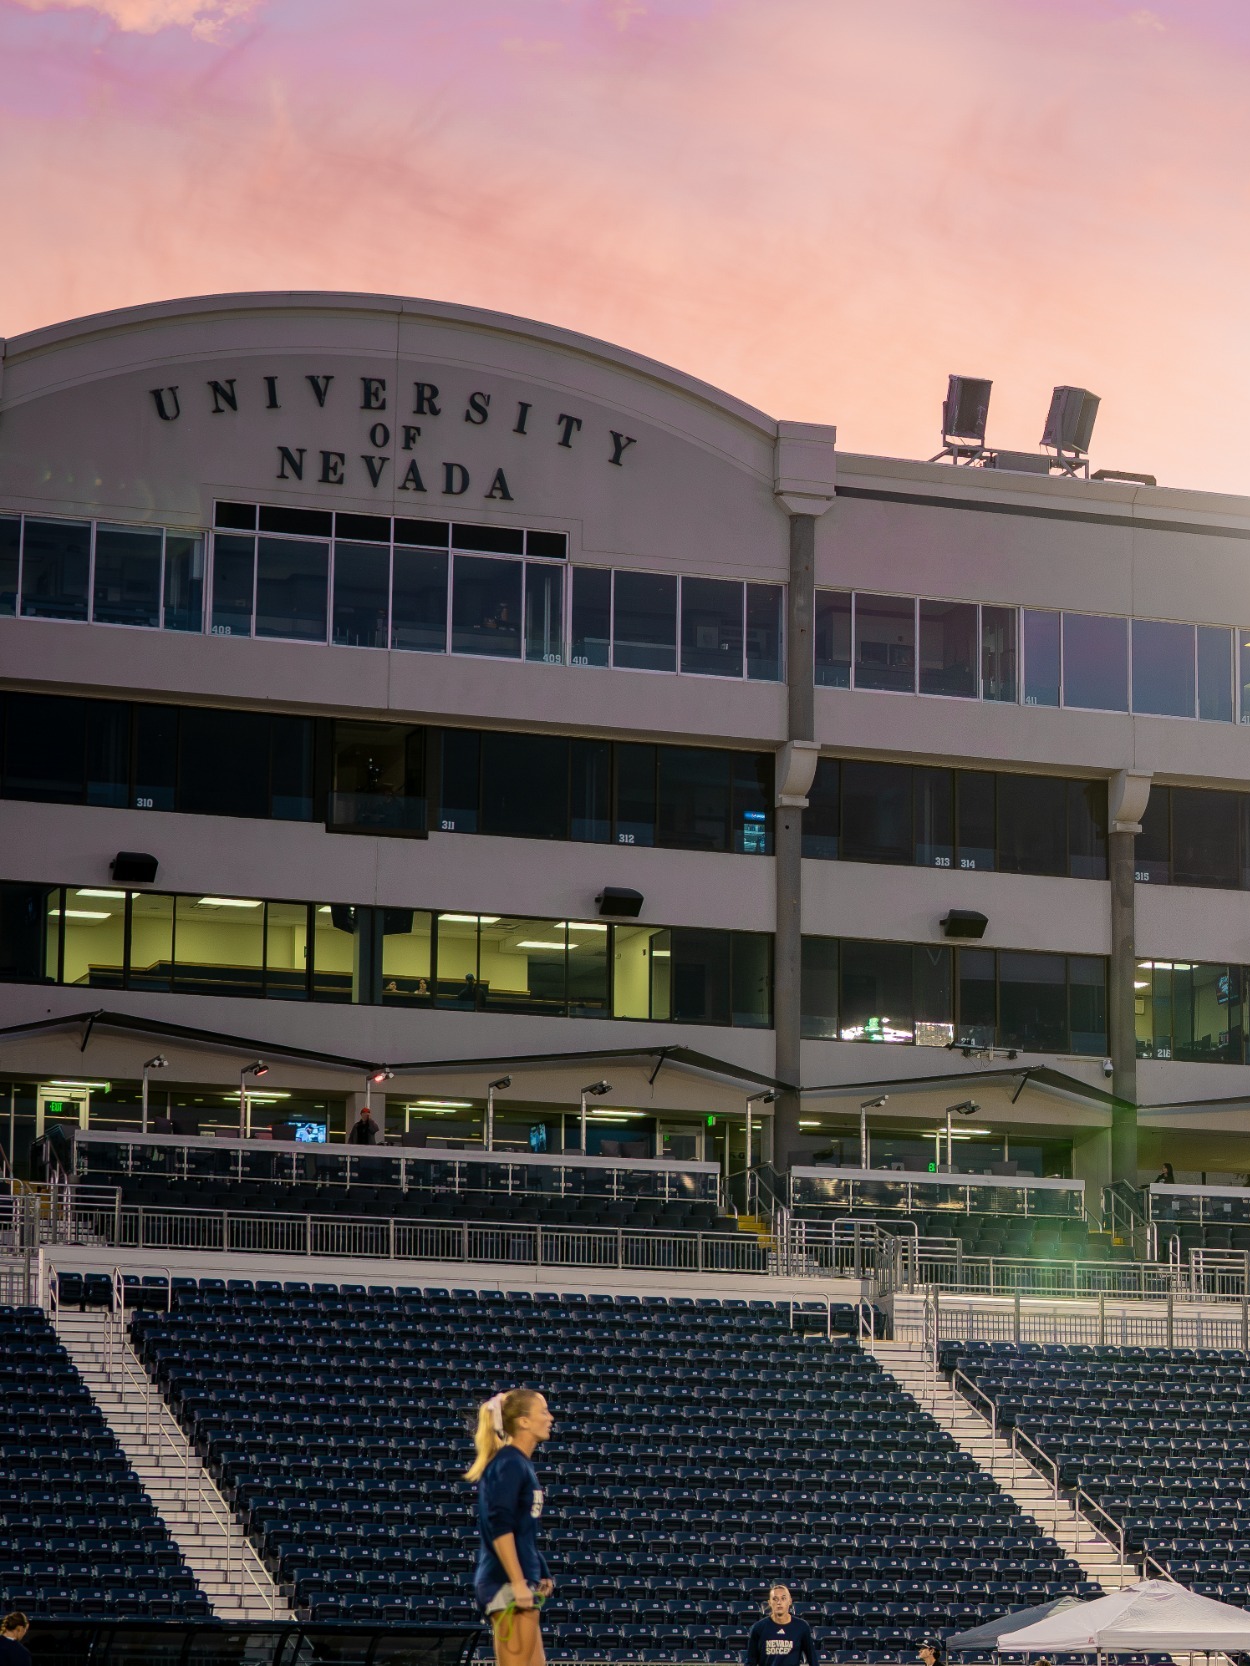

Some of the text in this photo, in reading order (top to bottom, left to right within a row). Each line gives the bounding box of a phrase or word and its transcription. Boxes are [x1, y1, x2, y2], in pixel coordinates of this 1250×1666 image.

[149, 374, 637, 467] UNIVERSITY
[369, 421, 422, 452] OF
[276, 445, 515, 502] NEVADA
[211, 625, 232, 635] 408
[542, 654, 562, 664] 409
[572, 656, 589, 666] 410
[136, 798, 154, 808] 310
[441, 821, 455, 830] 311
[618, 834, 635, 844] 312
[934, 857, 951, 867] 313
[960, 859, 976, 869] 314
[1134, 872, 1150, 881] 315
[766, 1640, 793, 1648] NEVADA
[766, 1647, 792, 1655] SOCCER
